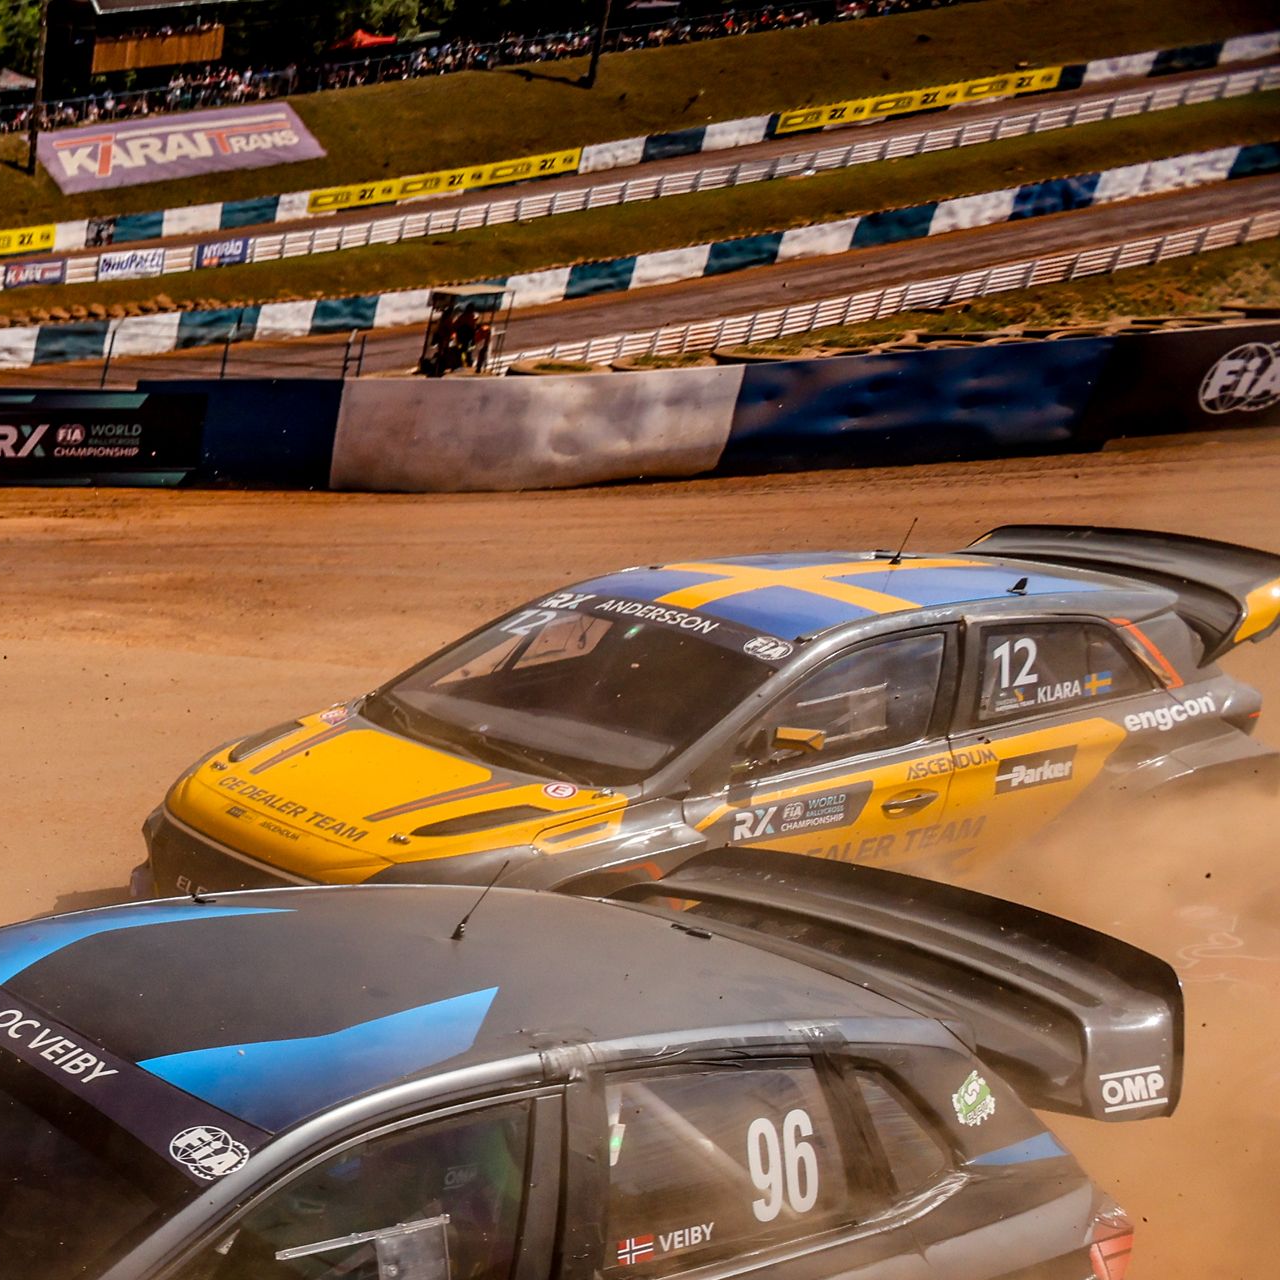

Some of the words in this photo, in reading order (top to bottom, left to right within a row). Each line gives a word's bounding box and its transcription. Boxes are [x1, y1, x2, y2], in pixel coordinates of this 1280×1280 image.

[90, 424, 142, 436] WORLD
[54, 446, 139, 457] CHAMPIONSHIP
[595, 599, 720, 635] ANDERSSON
[993, 637, 1038, 689] 12
[1037, 680, 1082, 704] KLARA
[907, 749, 998, 782] ASCENDUM
[1008, 760, 1073, 787] Parker
[218, 776, 246, 791] CE
[239, 784, 308, 818] DEALER
[305, 811, 369, 842] TEAM
[808, 794, 846, 809] WORLD
[733, 807, 778, 840] RX
[781, 813, 844, 832] CHAMPIONSHIP
[906, 815, 987, 850] TEAM
[27, 1028, 119, 1083] VEIBY
[1102, 1072, 1165, 1105] OMP
[747, 1108, 818, 1222] 96
[658, 1221, 715, 1254] VEIBY
